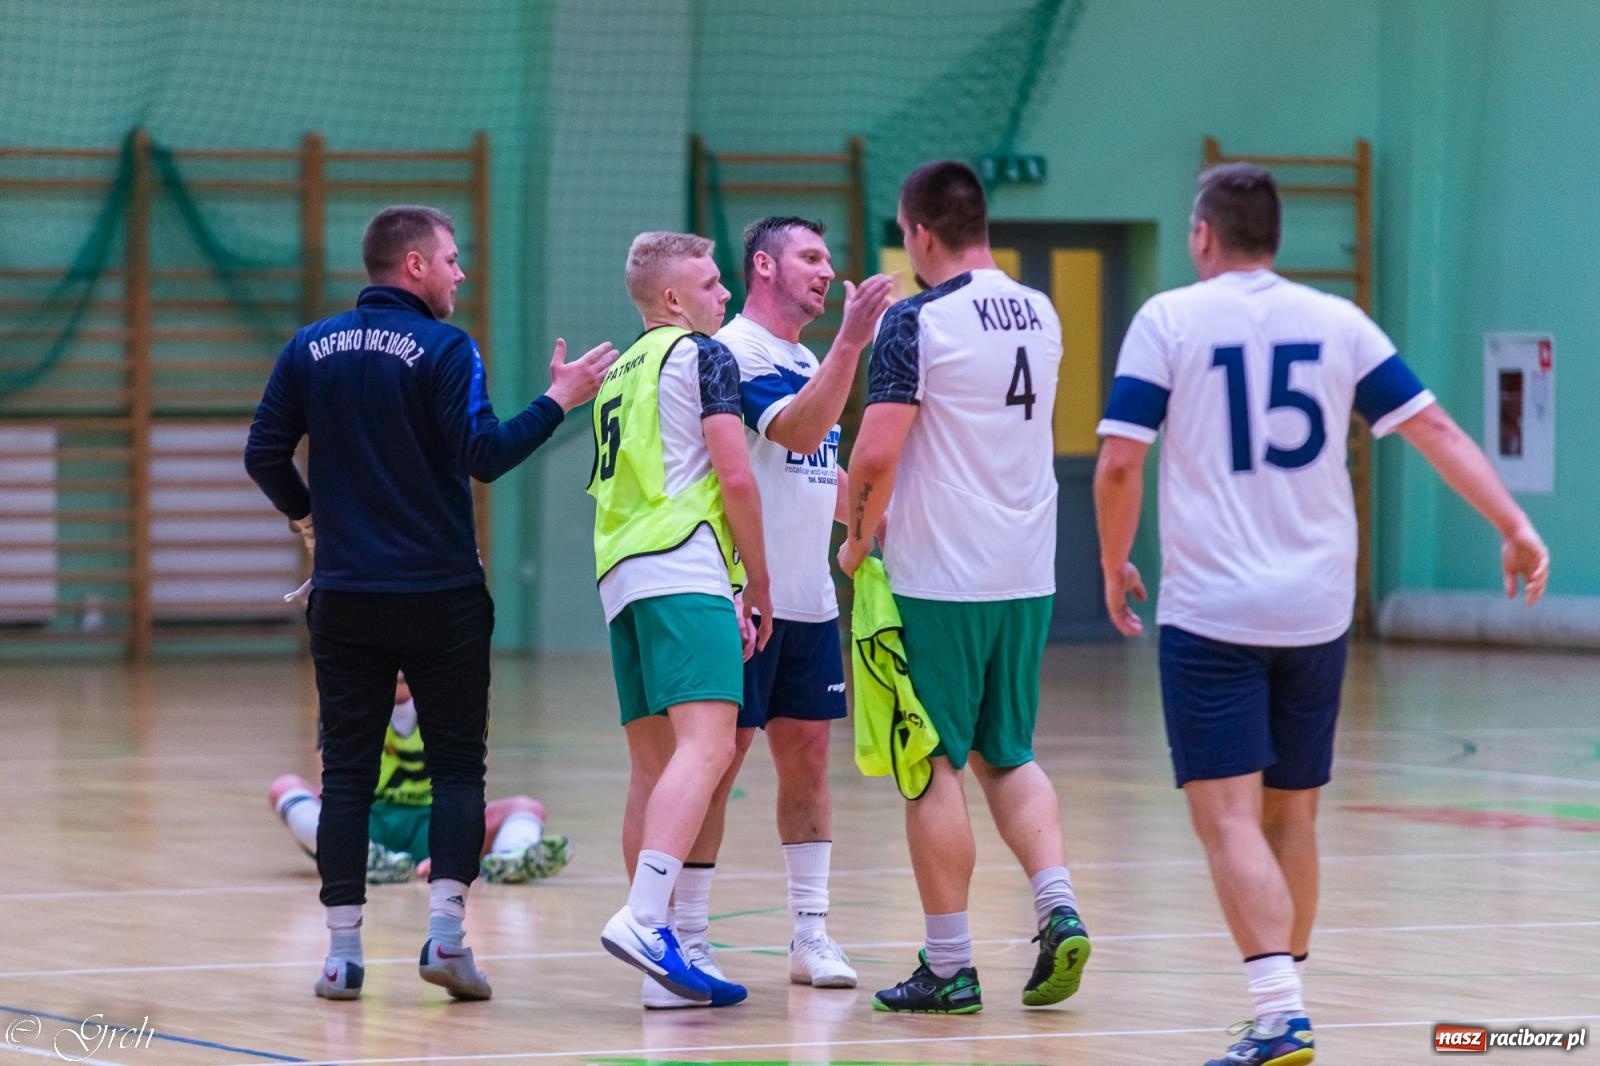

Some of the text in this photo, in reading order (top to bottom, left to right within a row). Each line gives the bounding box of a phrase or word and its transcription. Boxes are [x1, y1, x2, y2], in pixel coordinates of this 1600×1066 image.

[308, 328, 425, 368] RAFAKO RACIBÓRZ
[972, 297, 1043, 331] KUBA
[1005, 346, 1037, 421] 4
[1211, 341, 1327, 473] 15
[600, 393, 623, 481] 5
